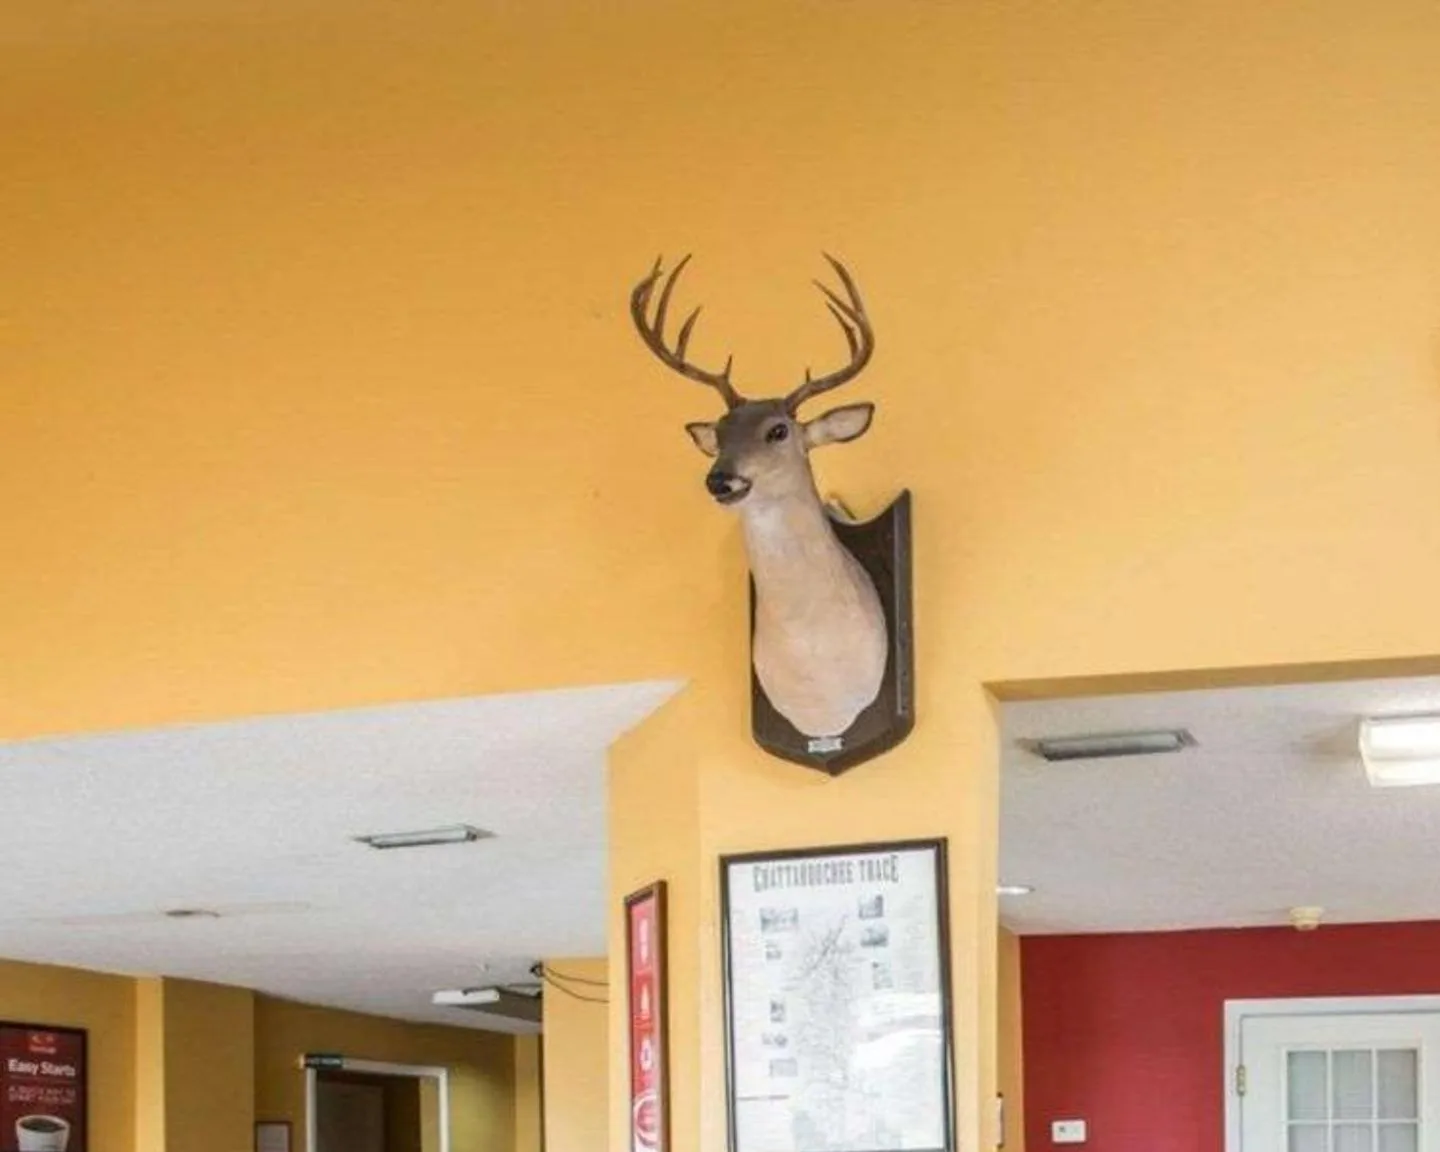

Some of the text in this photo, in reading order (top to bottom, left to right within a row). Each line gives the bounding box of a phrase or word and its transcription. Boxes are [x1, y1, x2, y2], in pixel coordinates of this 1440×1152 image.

[859, 854, 899, 883] TRACE
[8, 1058, 76, 1077] Easy Starts
